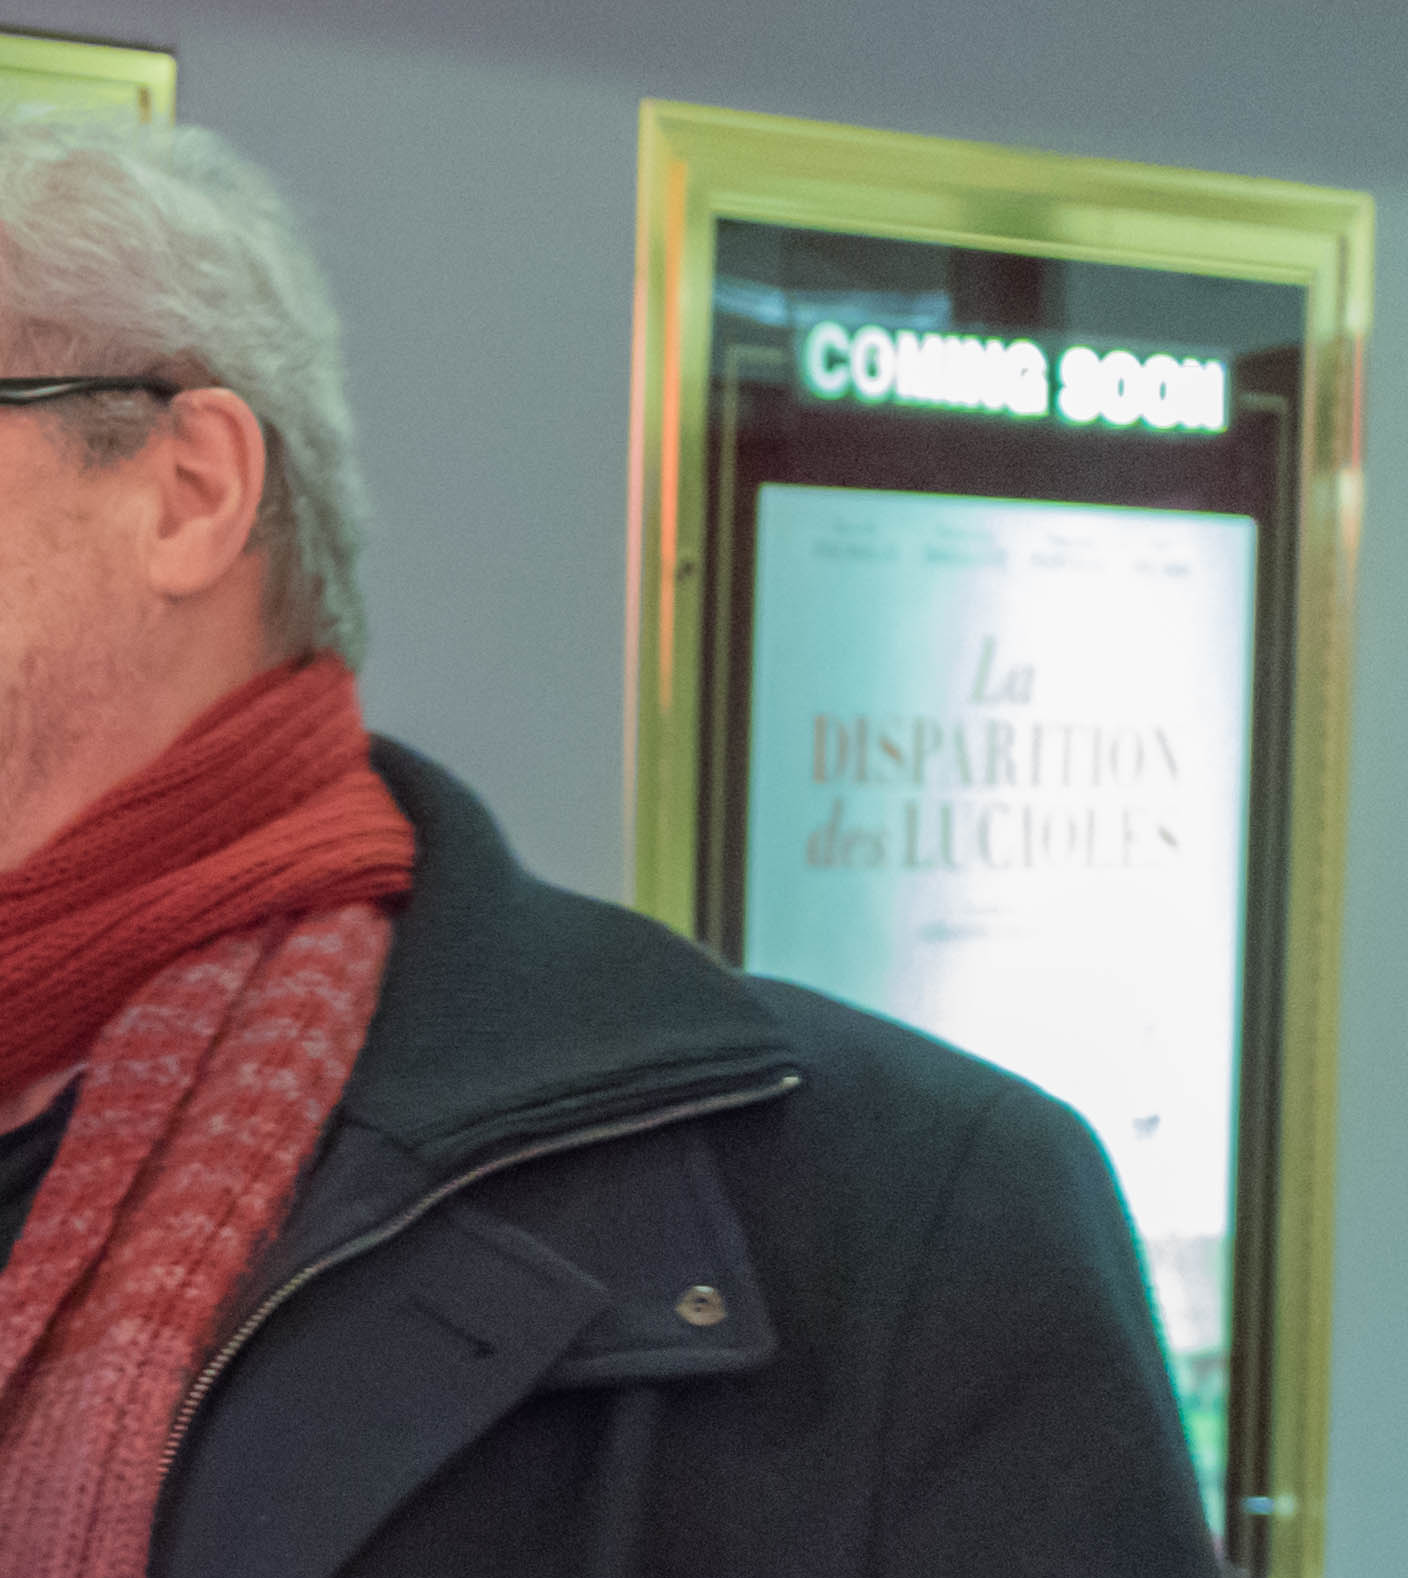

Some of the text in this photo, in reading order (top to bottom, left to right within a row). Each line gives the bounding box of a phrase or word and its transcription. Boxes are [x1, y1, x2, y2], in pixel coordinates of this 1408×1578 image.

[804, 322, 1228, 433] COMING SOON
[967, 633, 1036, 707] La
[812, 714, 1181, 789] DISPARITION
[804, 797, 1183, 873] des LUCIOLES
